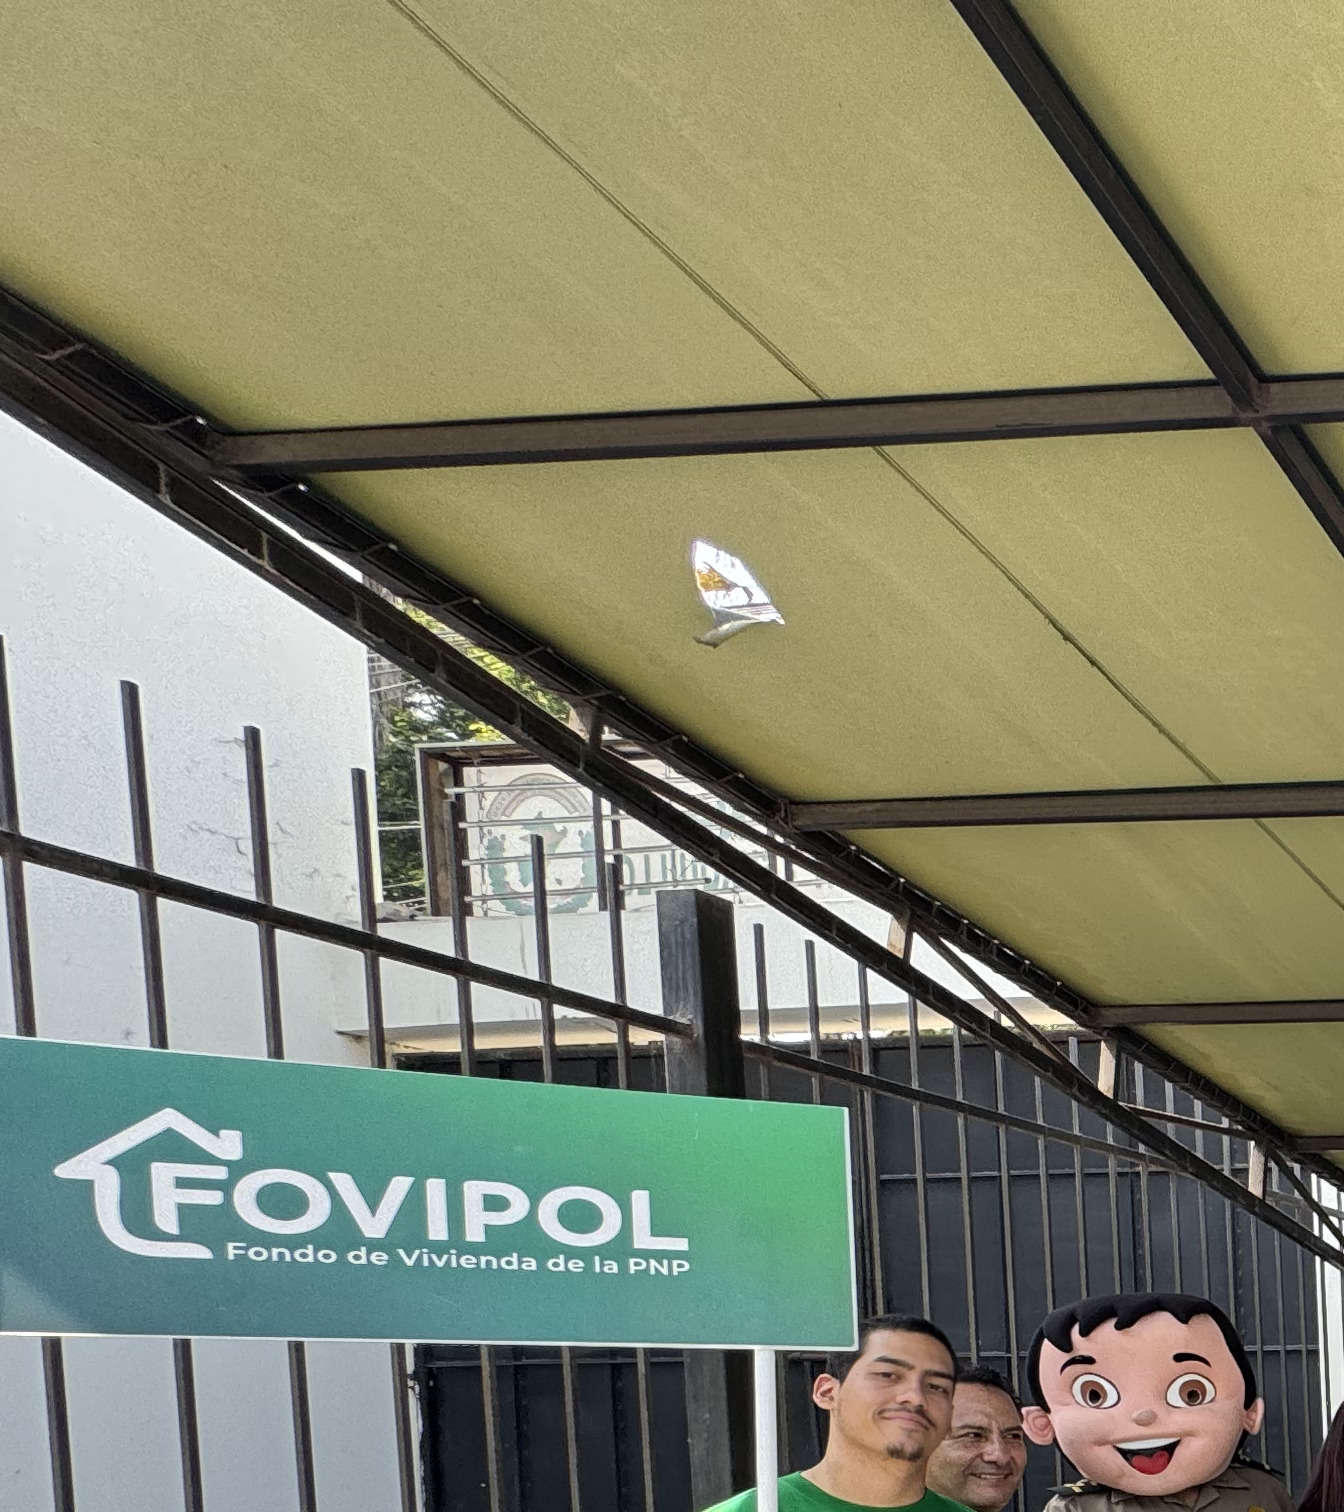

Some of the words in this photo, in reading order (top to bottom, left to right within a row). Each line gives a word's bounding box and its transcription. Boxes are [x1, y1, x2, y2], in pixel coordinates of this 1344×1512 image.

[150, 1162, 690, 1251] FOVIPOL
[226, 1241, 338, 1266] Fondo
[347, 1245, 389, 1267] de
[397, 1248, 538, 1273] Vivienda
[547, 1252, 584, 1273] de
[594, 1253, 620, 1274] la
[628, 1257, 690, 1277] PNP
